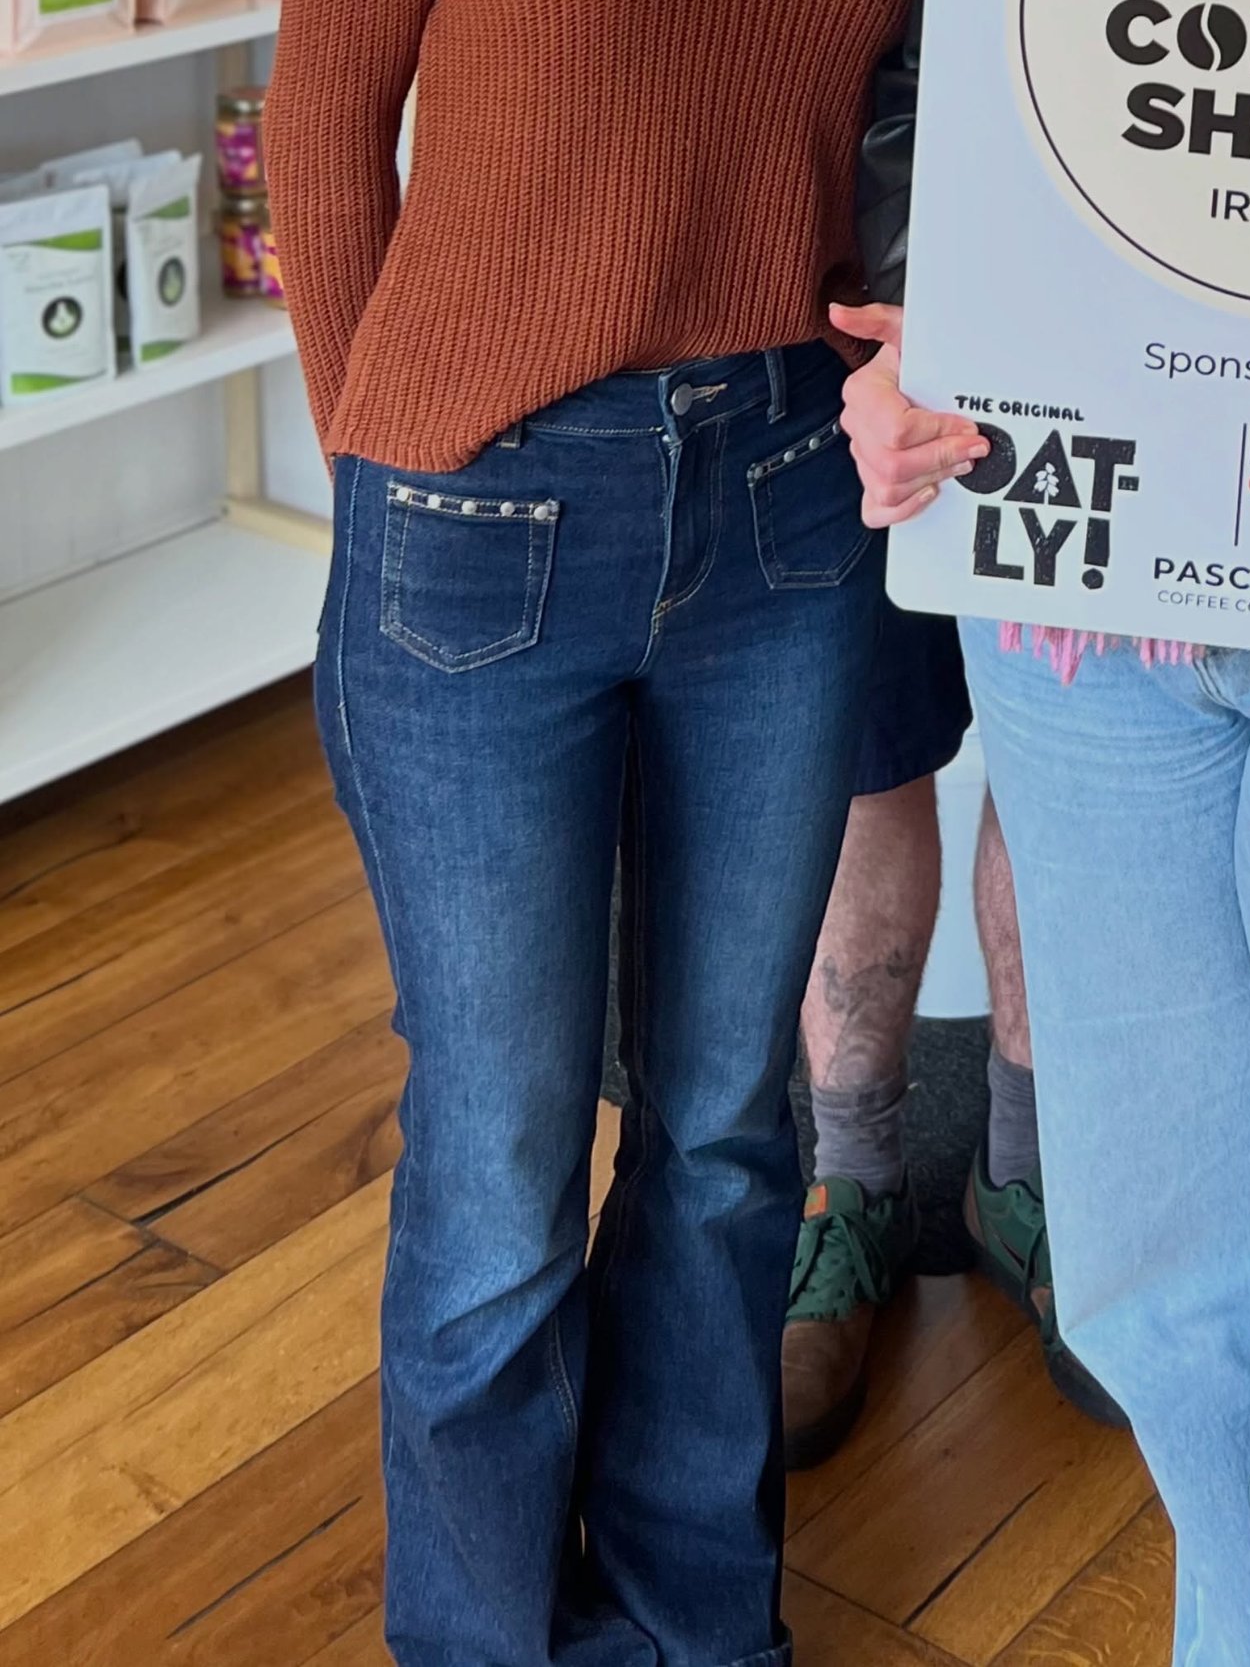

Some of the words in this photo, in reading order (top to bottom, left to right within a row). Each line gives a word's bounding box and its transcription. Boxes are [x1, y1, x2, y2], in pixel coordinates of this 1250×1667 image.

[954, 395, 994, 413] THE
[999, 401, 1085, 421] ORIGINAL
[972, 504, 1110, 590] LY!
[1157, 590, 1231, 611] COFFEE
